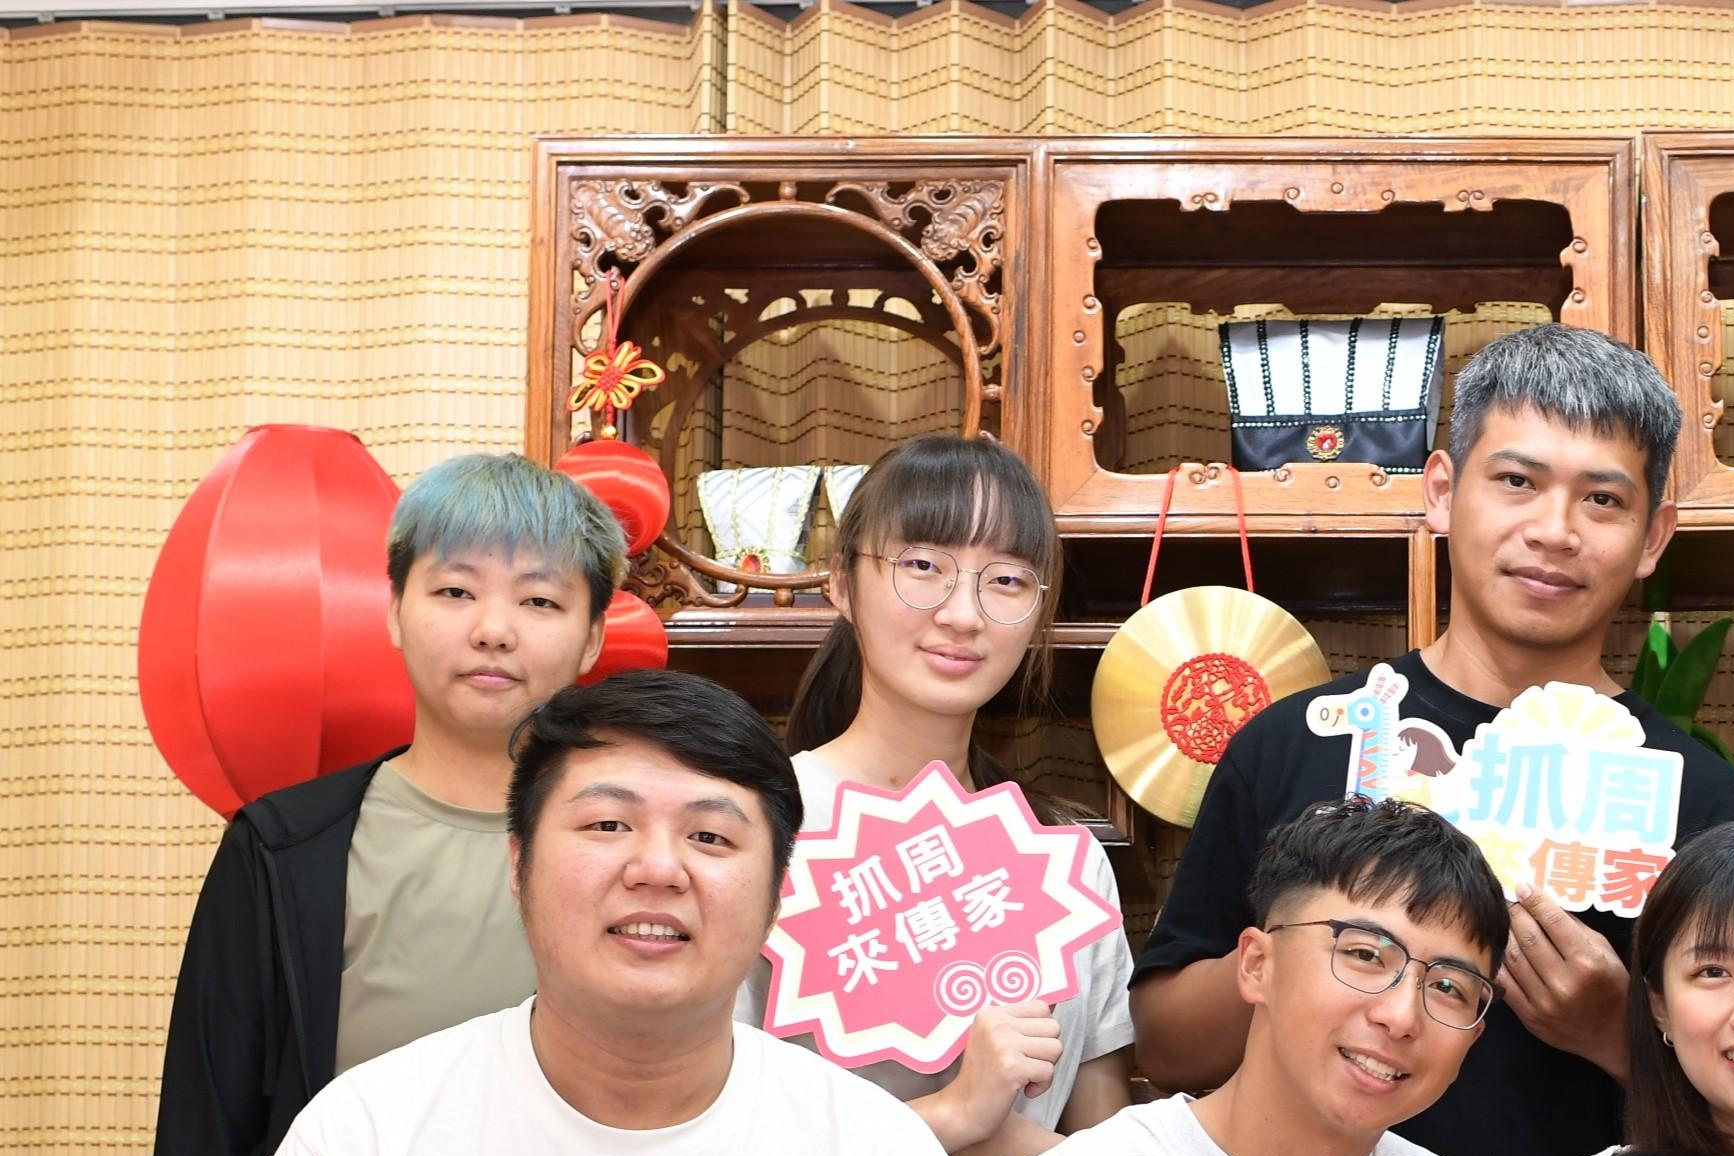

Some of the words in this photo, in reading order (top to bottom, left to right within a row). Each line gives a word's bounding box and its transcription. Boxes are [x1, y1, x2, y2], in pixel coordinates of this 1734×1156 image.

[1465, 733, 1675, 845] 抓周
[828, 867, 1024, 993] 來傳家
[831, 824, 964, 926] 抓周
